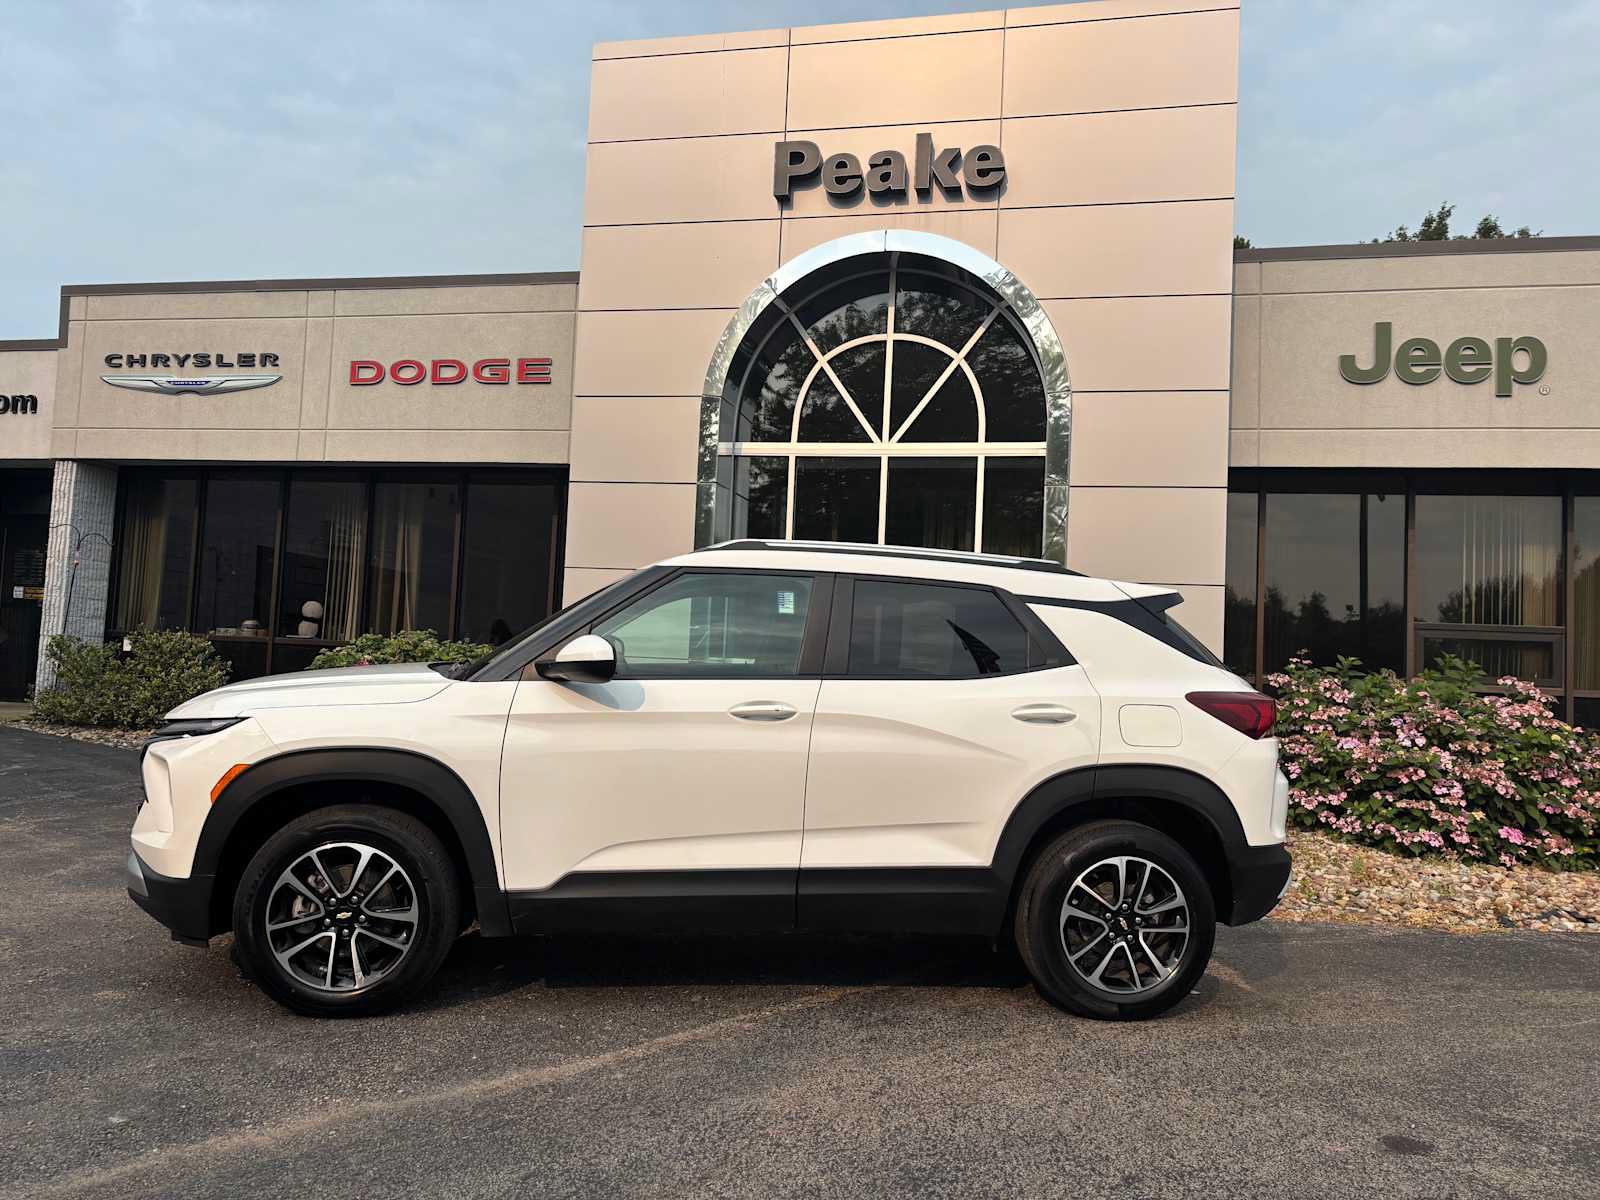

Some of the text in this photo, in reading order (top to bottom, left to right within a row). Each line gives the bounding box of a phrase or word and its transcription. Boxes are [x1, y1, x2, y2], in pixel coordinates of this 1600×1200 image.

[773, 133, 1006, 201] Peake
[104, 352, 280, 368] CHRYSLER
[350, 358, 553, 385] DODGE
[1338, 321, 1548, 397] Jeep
